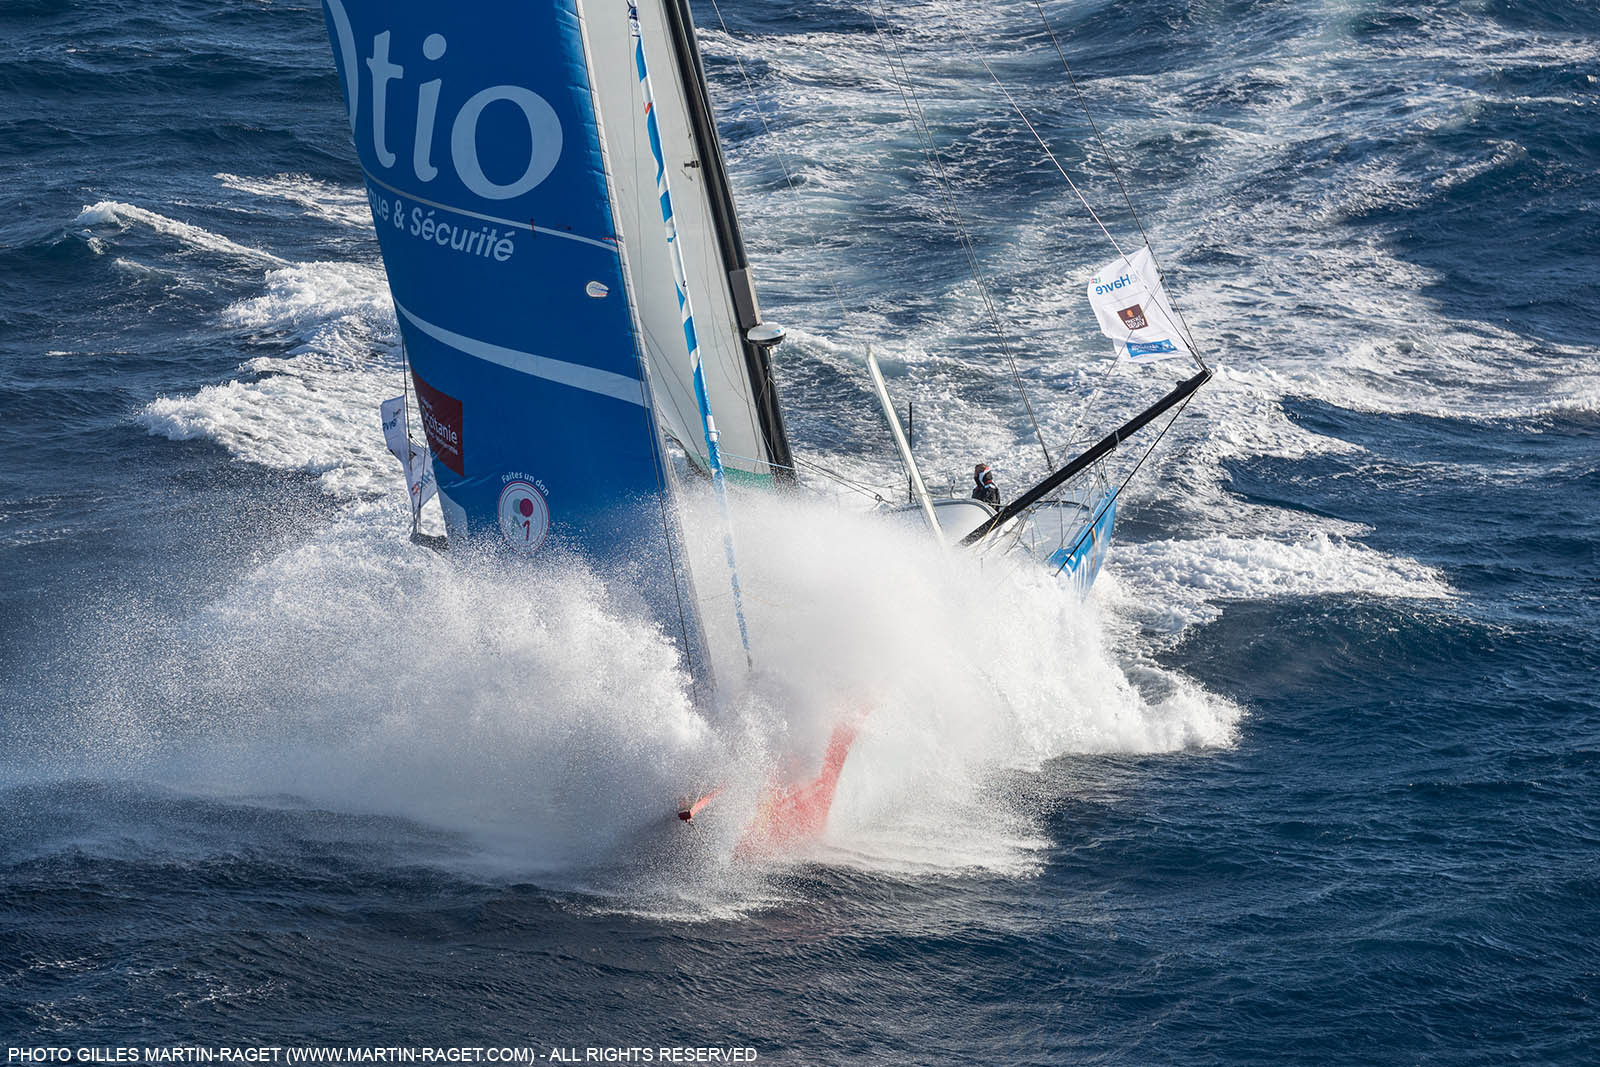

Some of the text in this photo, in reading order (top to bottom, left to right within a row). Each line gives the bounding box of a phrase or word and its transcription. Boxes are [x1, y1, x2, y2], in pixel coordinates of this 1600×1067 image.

[326, 0, 563, 200] tio
[393, 199, 405, 230] &
[410, 207, 516, 262] Sécurité
[501, 471, 550, 496] Faites un don
